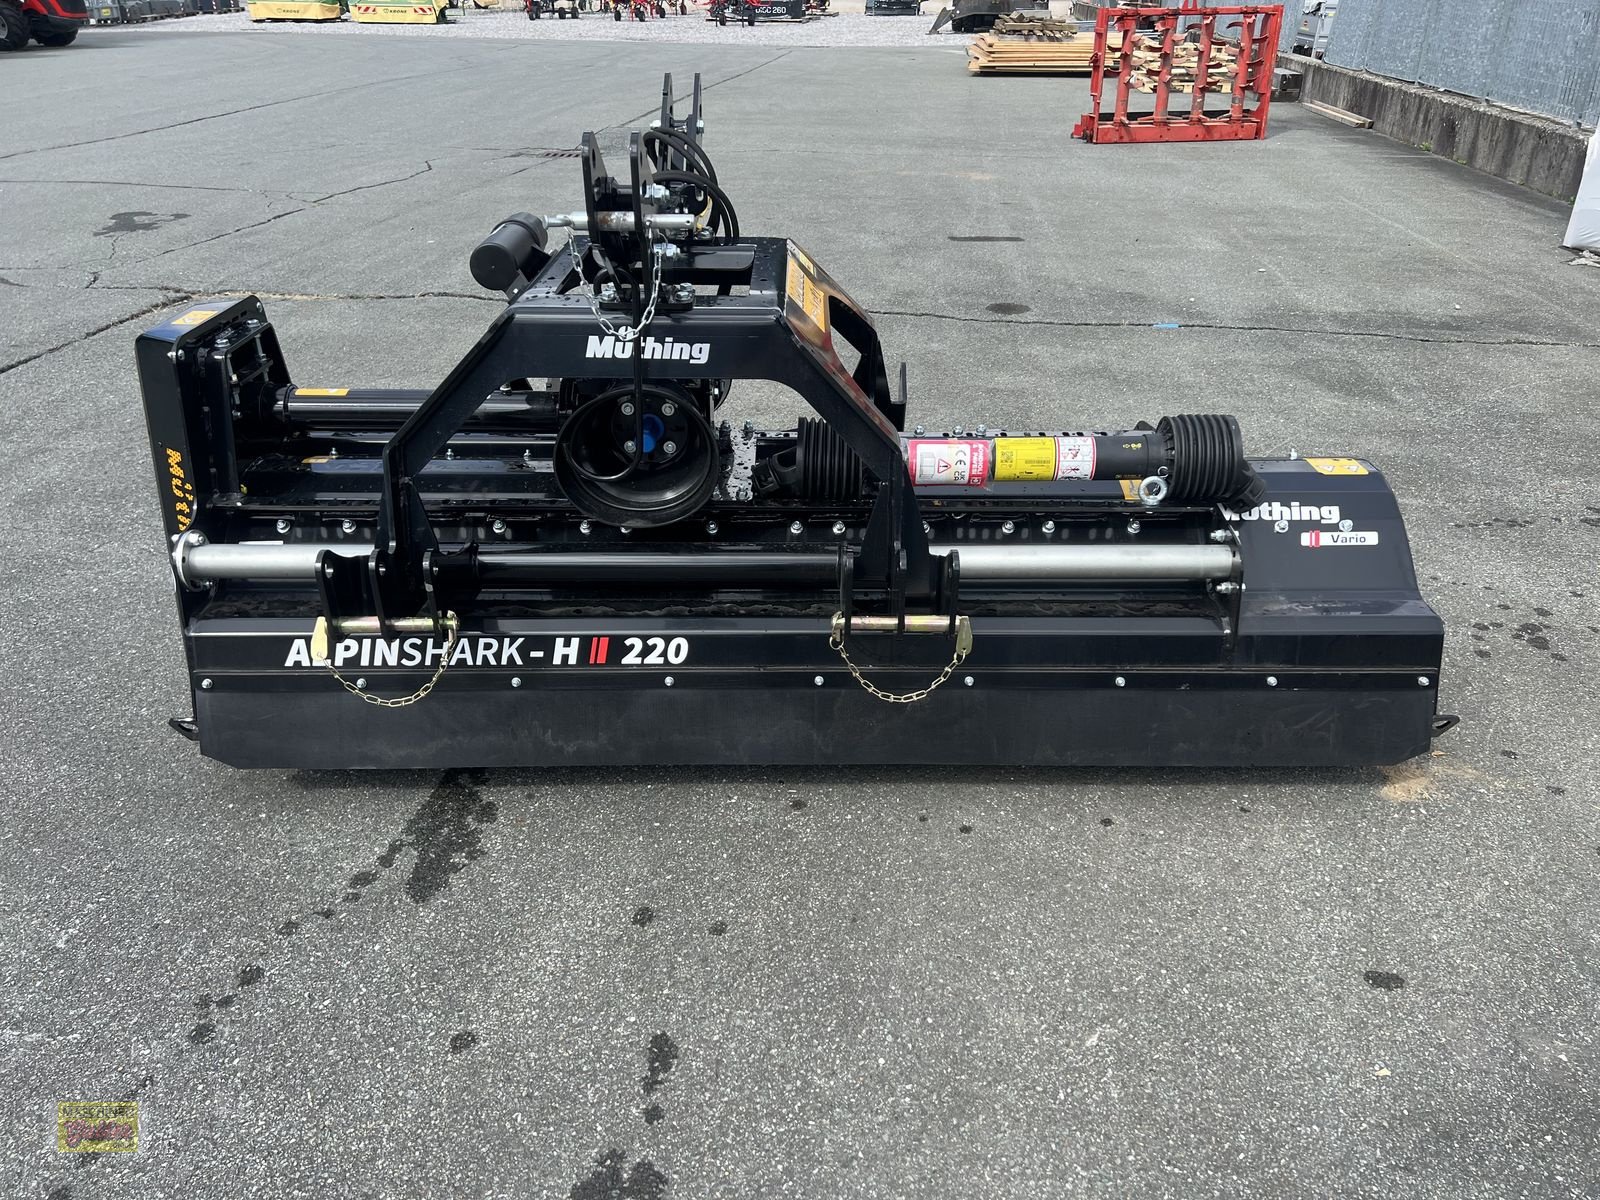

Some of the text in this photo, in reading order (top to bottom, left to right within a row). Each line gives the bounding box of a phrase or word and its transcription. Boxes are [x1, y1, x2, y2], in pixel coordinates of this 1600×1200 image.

[772, 6, 787, 14] 260
[1331, 534, 1367, 543] Vario
[284, 638, 525, 667] APINSHARK
[621, 636, 689, 665] 220
